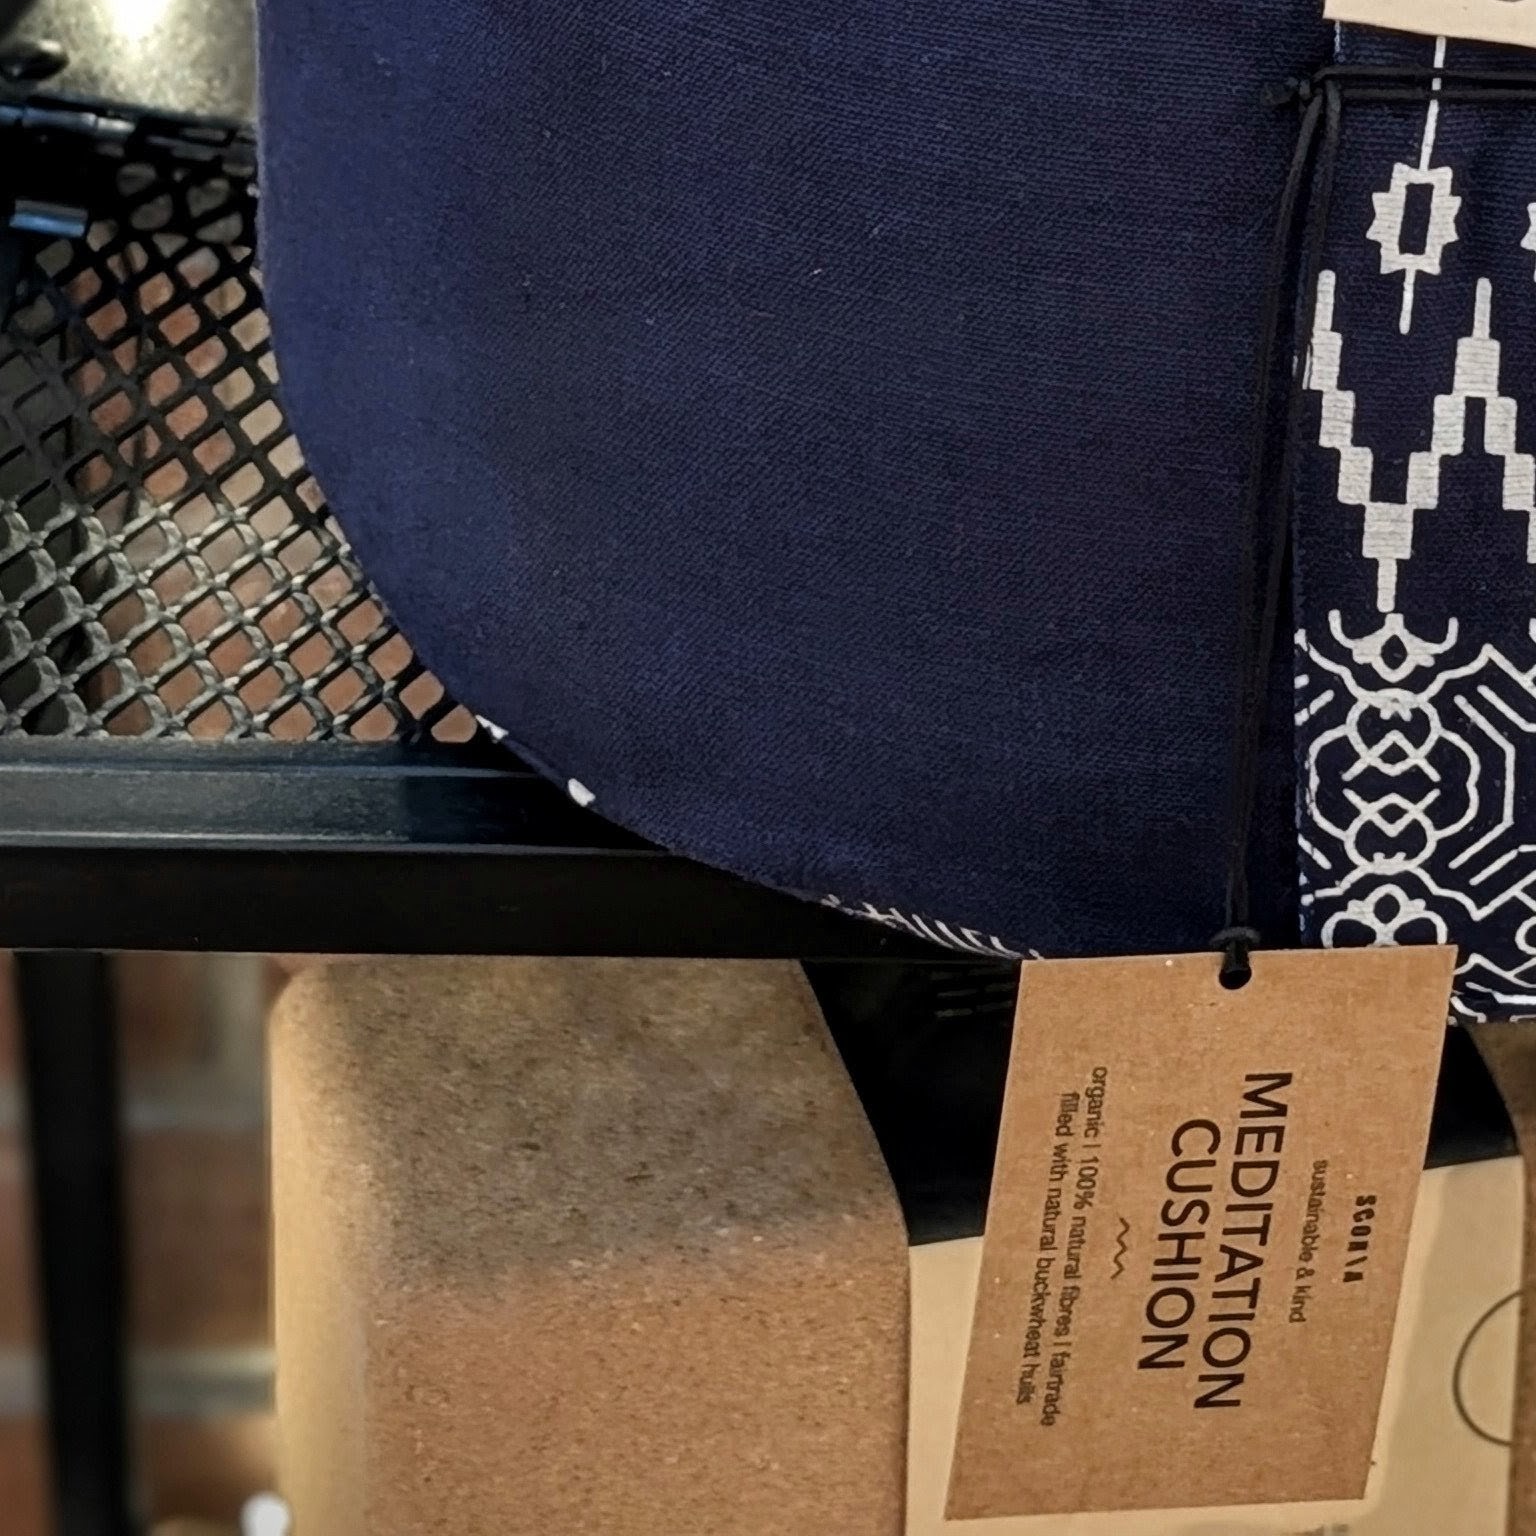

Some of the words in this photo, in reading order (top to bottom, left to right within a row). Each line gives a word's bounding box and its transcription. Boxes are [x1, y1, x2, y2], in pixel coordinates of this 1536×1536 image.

[1055, 1091, 1080, 1137] filled
[1083, 1066, 1109, 1138] organic
[1047, 1143, 1071, 1182] with
[1073, 1156, 1099, 1211] 100%
[1039, 1188, 1064, 1251] natural
[1194, 1071, 1293, 1409] MEDITATION
[1299, 1159, 1329, 1263] sustainable
[1063, 1216, 1089, 1280] natural
[1137, 1119, 1221, 1371] CUSHION
[1296, 1267, 1316, 1281] &
[1022, 1257, 1056, 1358] buckwheat
[1054, 1285, 1080, 1337] fibres
[1289, 1284, 1313, 1324] kind
[1016, 1363, 1039, 1405] hulls
[1041, 1351, 1070, 1427] fairtrade
